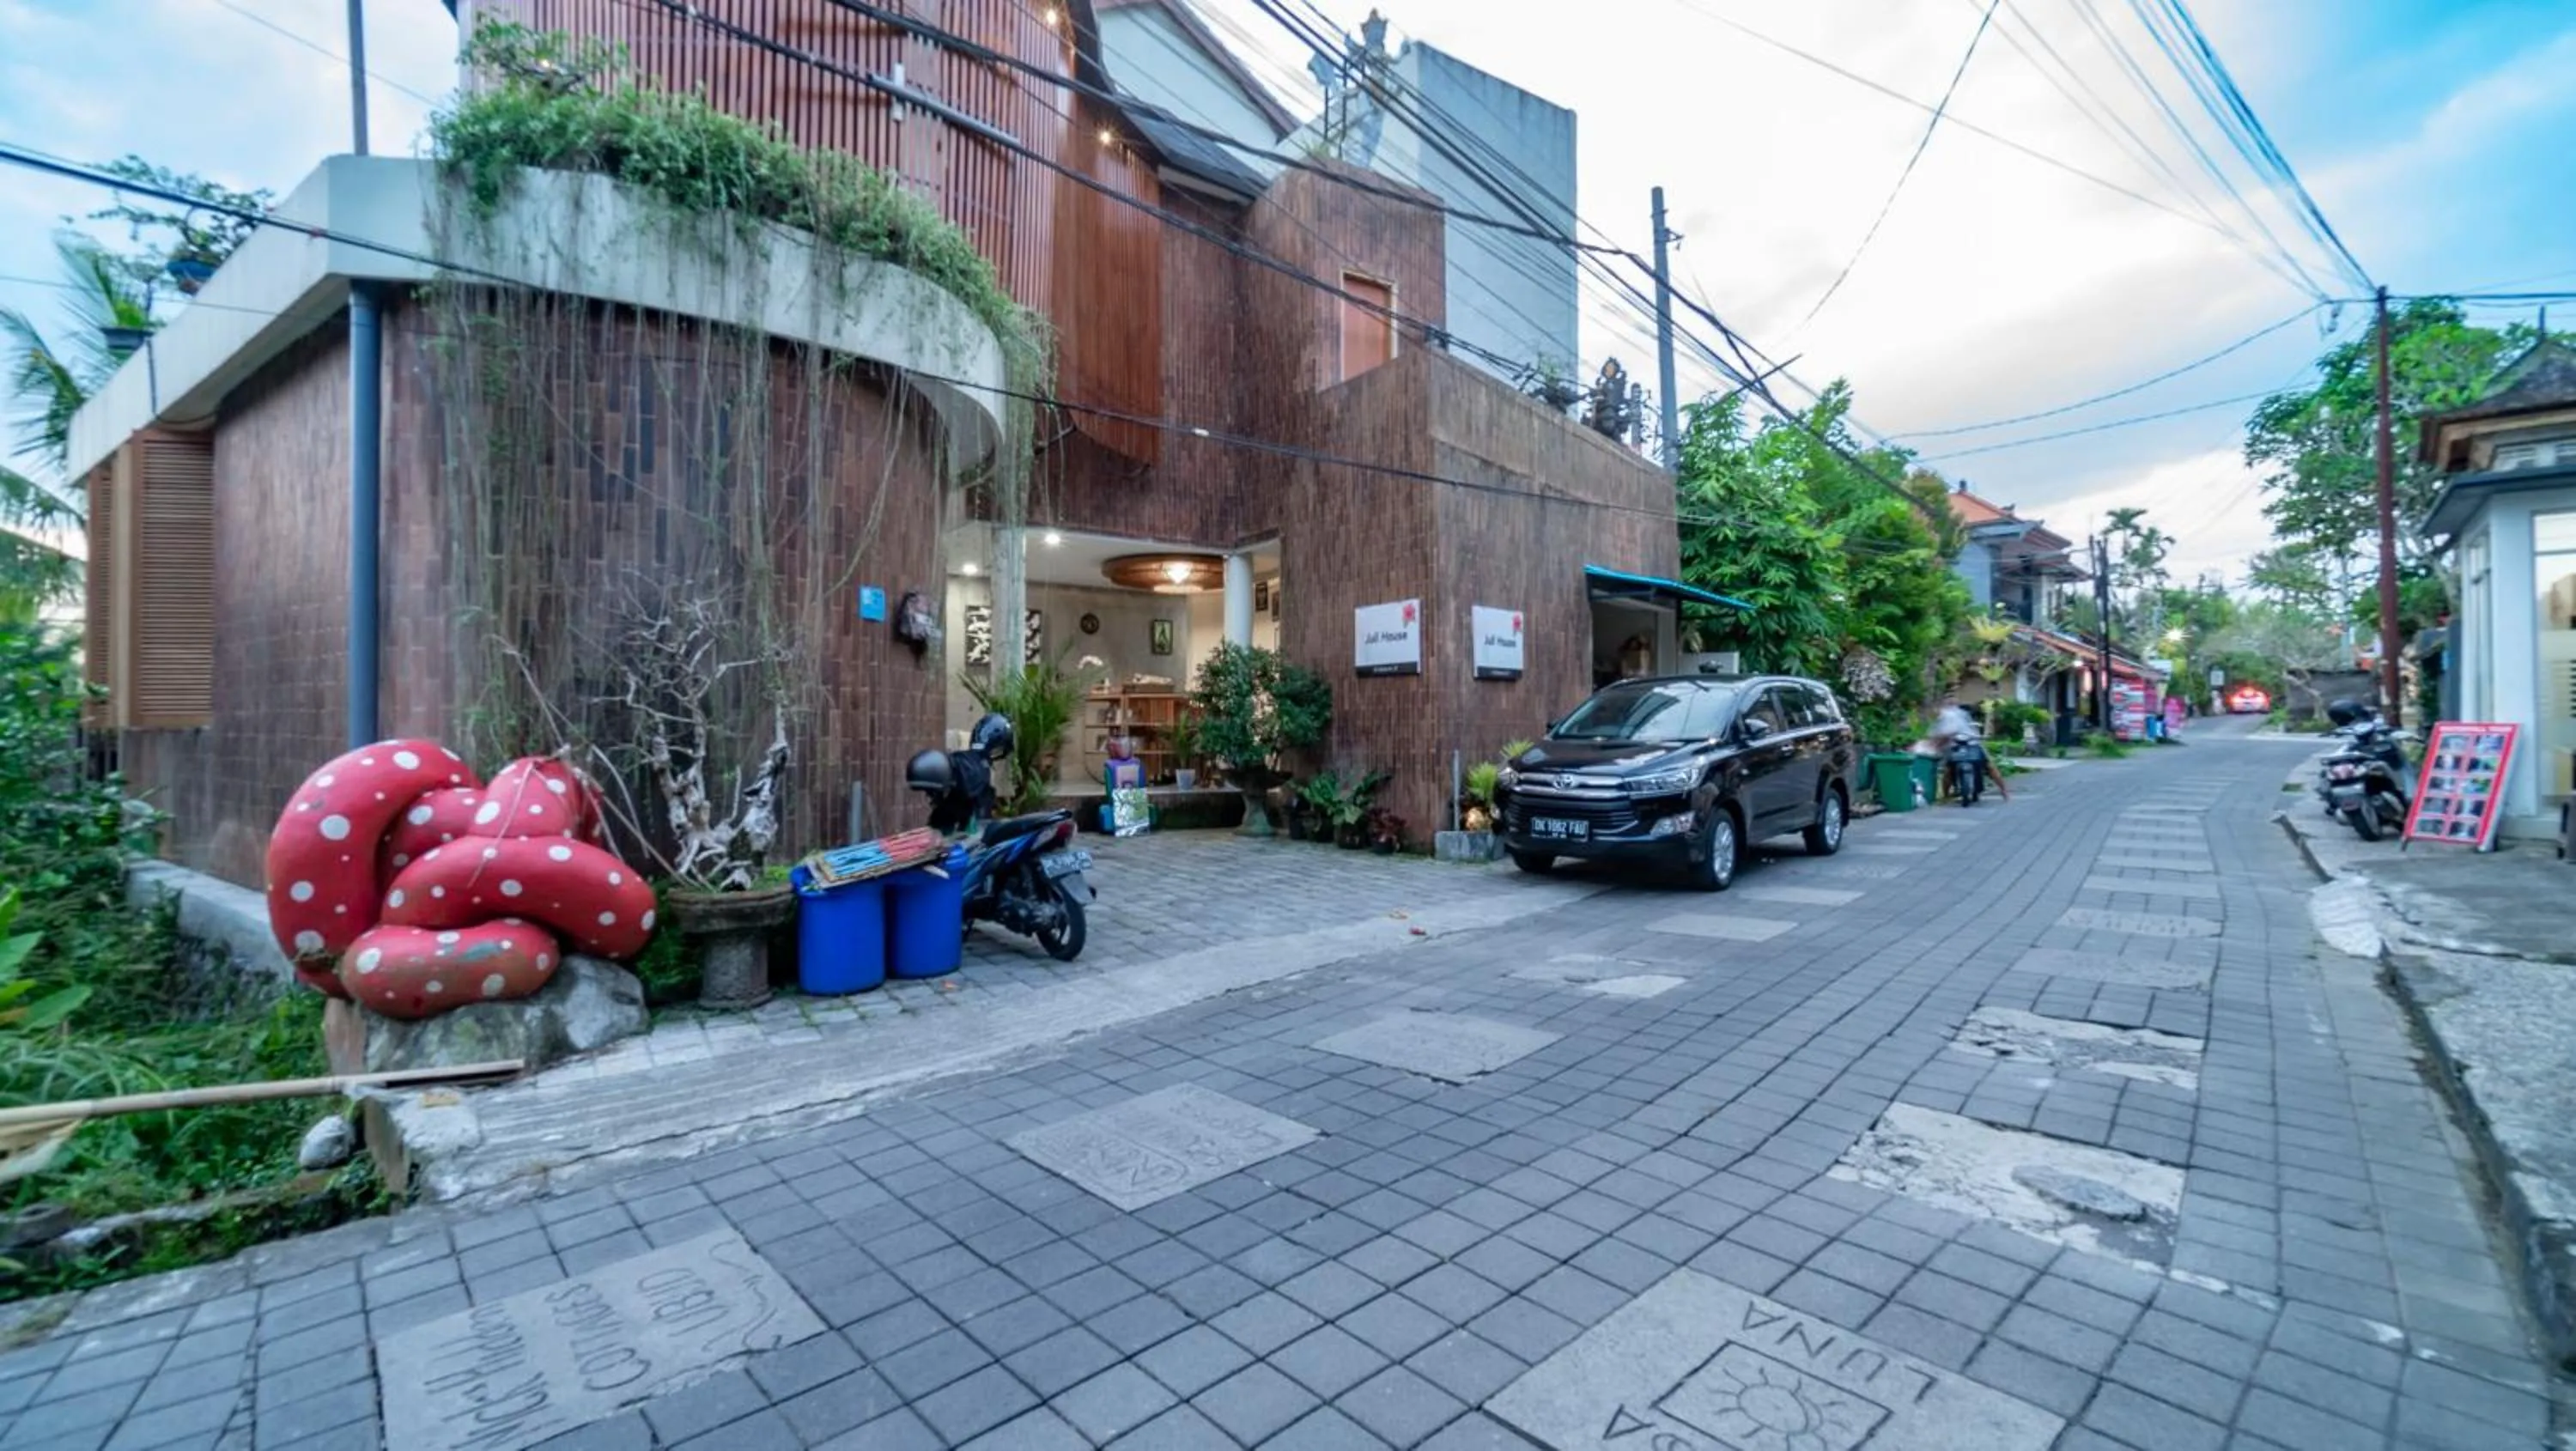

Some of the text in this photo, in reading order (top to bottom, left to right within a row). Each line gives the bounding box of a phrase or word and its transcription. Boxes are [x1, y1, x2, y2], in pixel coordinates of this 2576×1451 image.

[1381, 631, 1408, 643] House
[544, 1283, 652, 1392] COTTAGES
[636, 1266, 730, 1338] UBUD
[1742, 1300, 1939, 1405] LUNA
